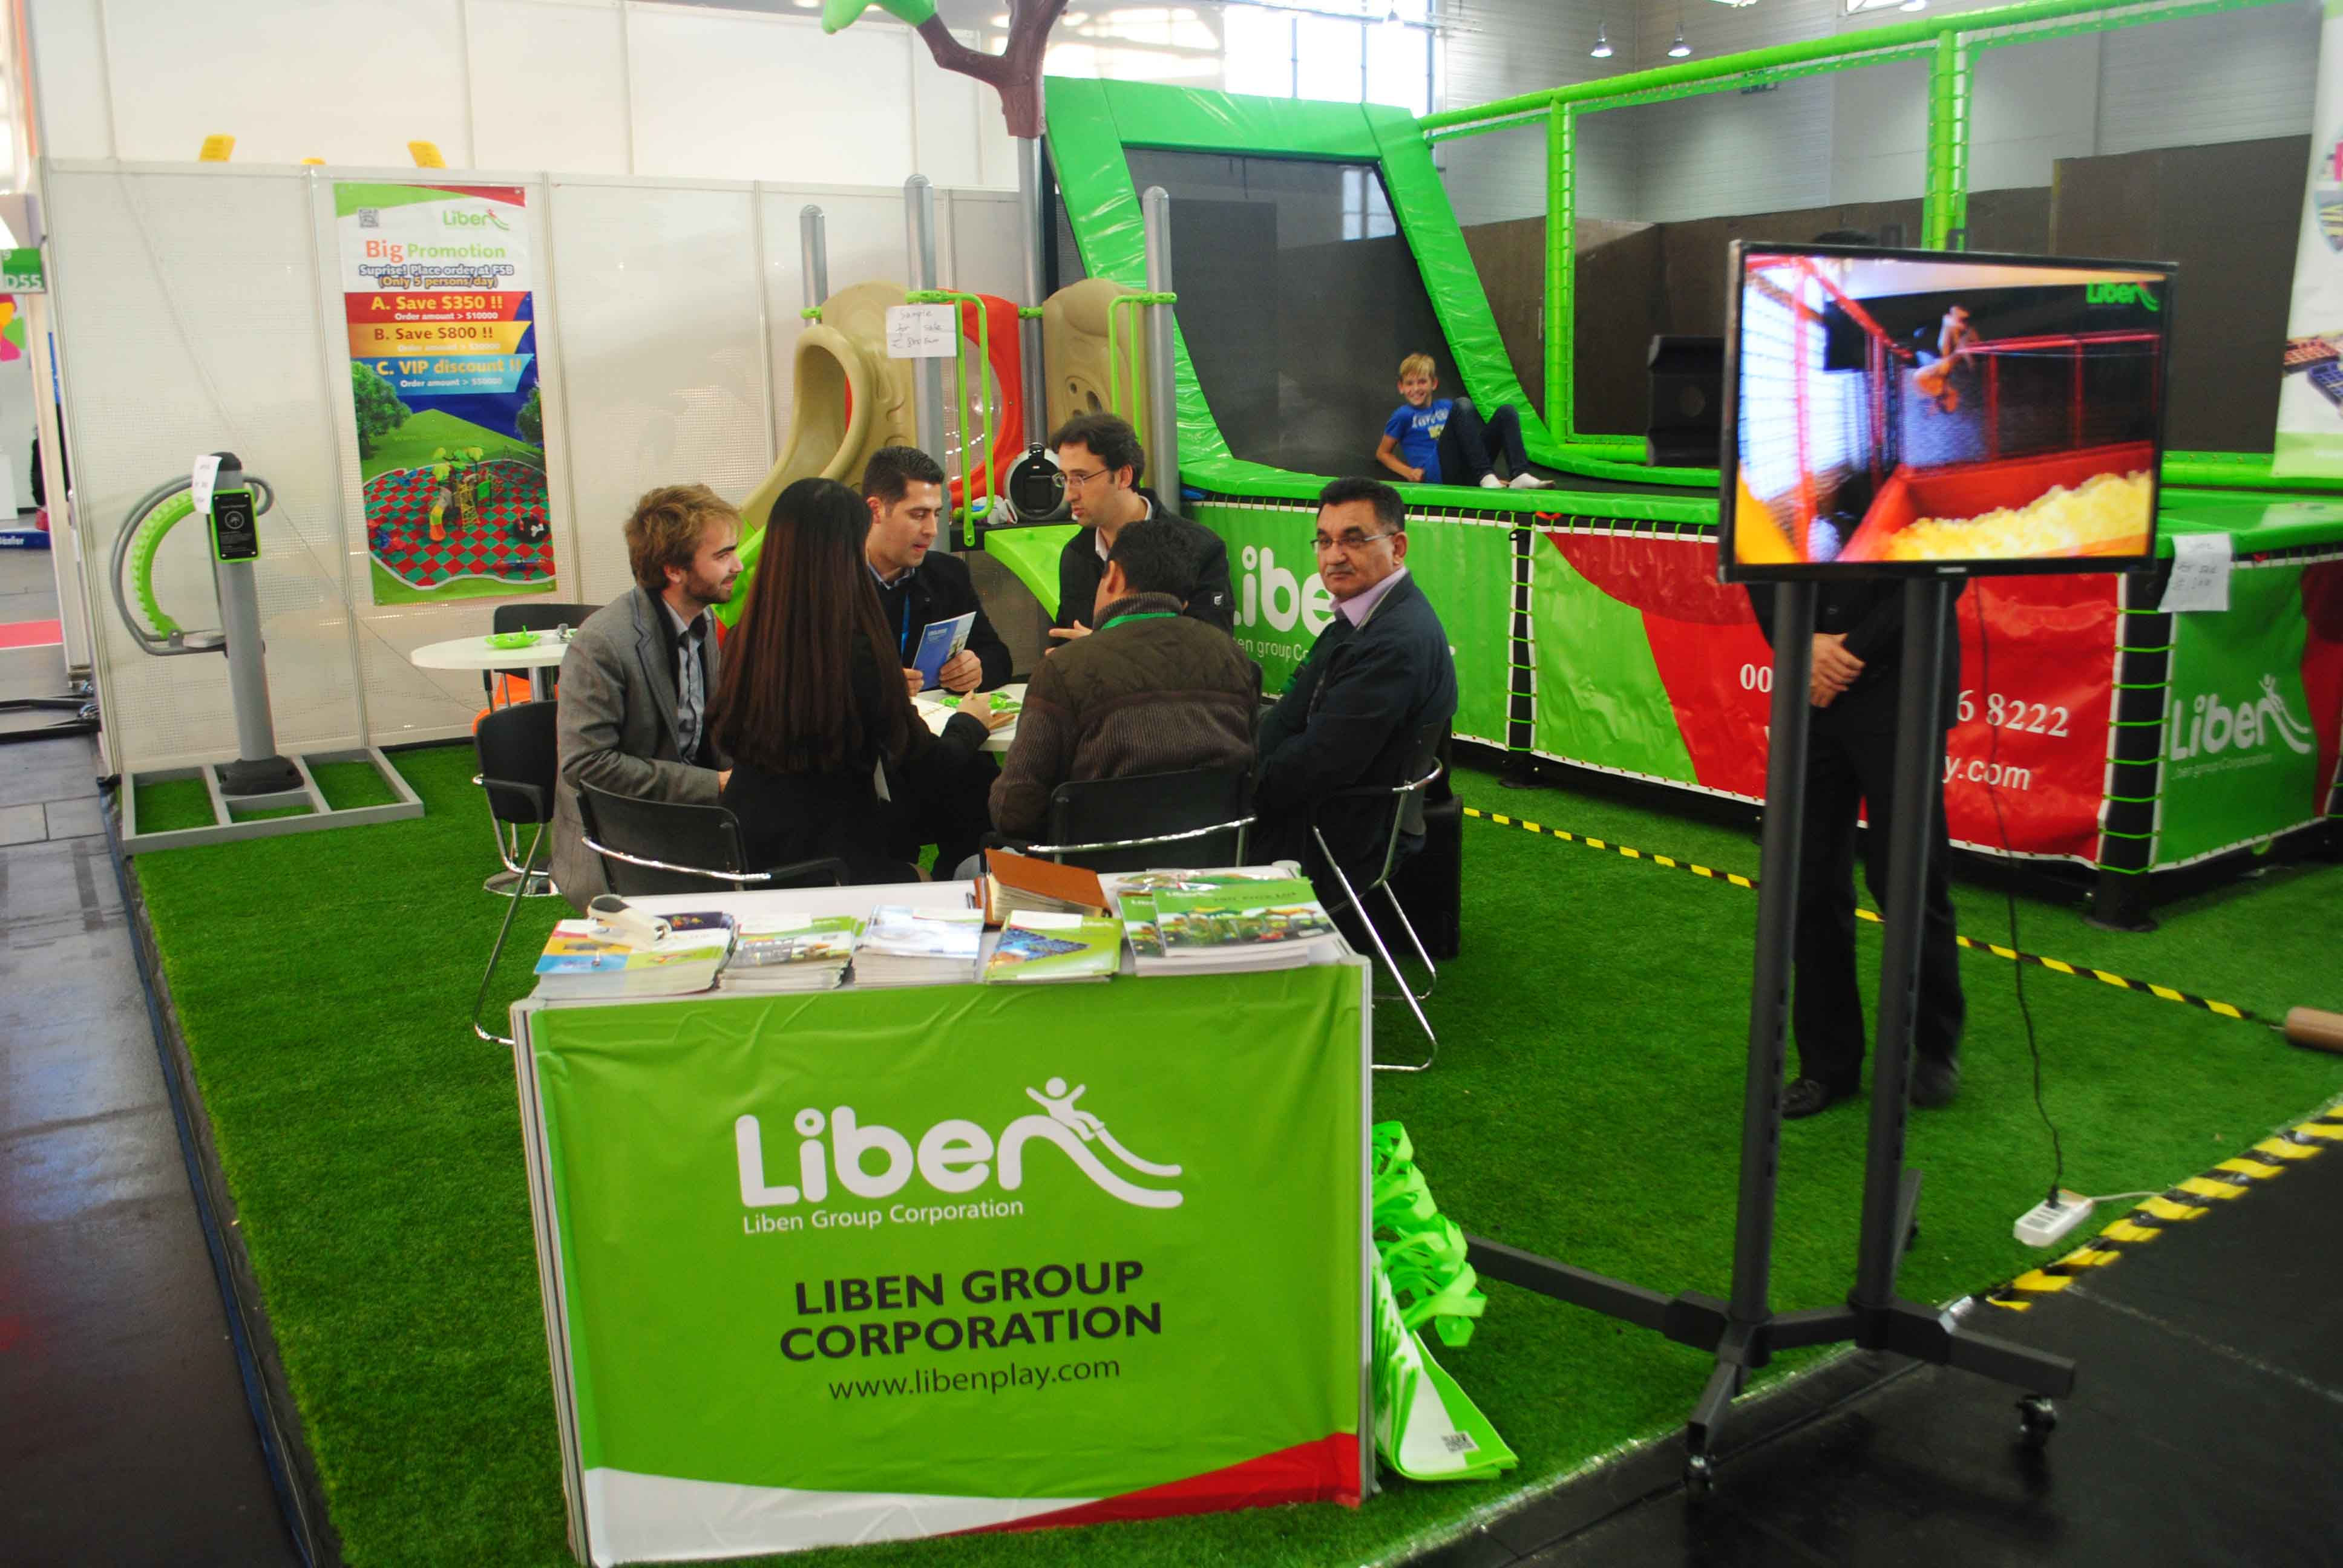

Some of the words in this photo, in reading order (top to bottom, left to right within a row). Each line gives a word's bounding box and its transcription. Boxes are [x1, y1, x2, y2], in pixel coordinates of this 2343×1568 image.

[366, 240, 404, 263] Big
[408, 243, 506, 258] Promotion
[410, 264, 441, 276] Place
[378, 276, 410, 289] (Only
[414, 276, 422, 287] 5
[371, 297, 391, 310] A.
[396, 296, 437, 310] Save
[491, 295, 503, 309] !!
[374, 328, 389, 340] B.
[395, 328, 433, 339] Save
[483, 327, 493, 339] !!
[377, 361, 395, 376] C.
[399, 361, 429, 374] VIP
[433, 358, 504, 374] discount
[400, 379, 425, 387] Order
[1233, 545, 1335, 637] ibe
[1257, 641, 1292, 662] group
[1987, 693, 2069, 737] 8222
[743, 1213, 804, 1235] Liben
[811, 1207, 882, 1229] Group
[890, 1199, 1024, 1226] Corporation
[795, 1273, 944, 1316] LIBEN
[961, 1260, 1144, 1304] GROUP
[779, 1302, 1162, 1362] CORPORATION
[829, 1359, 1121, 1400] www.libenplay.com
